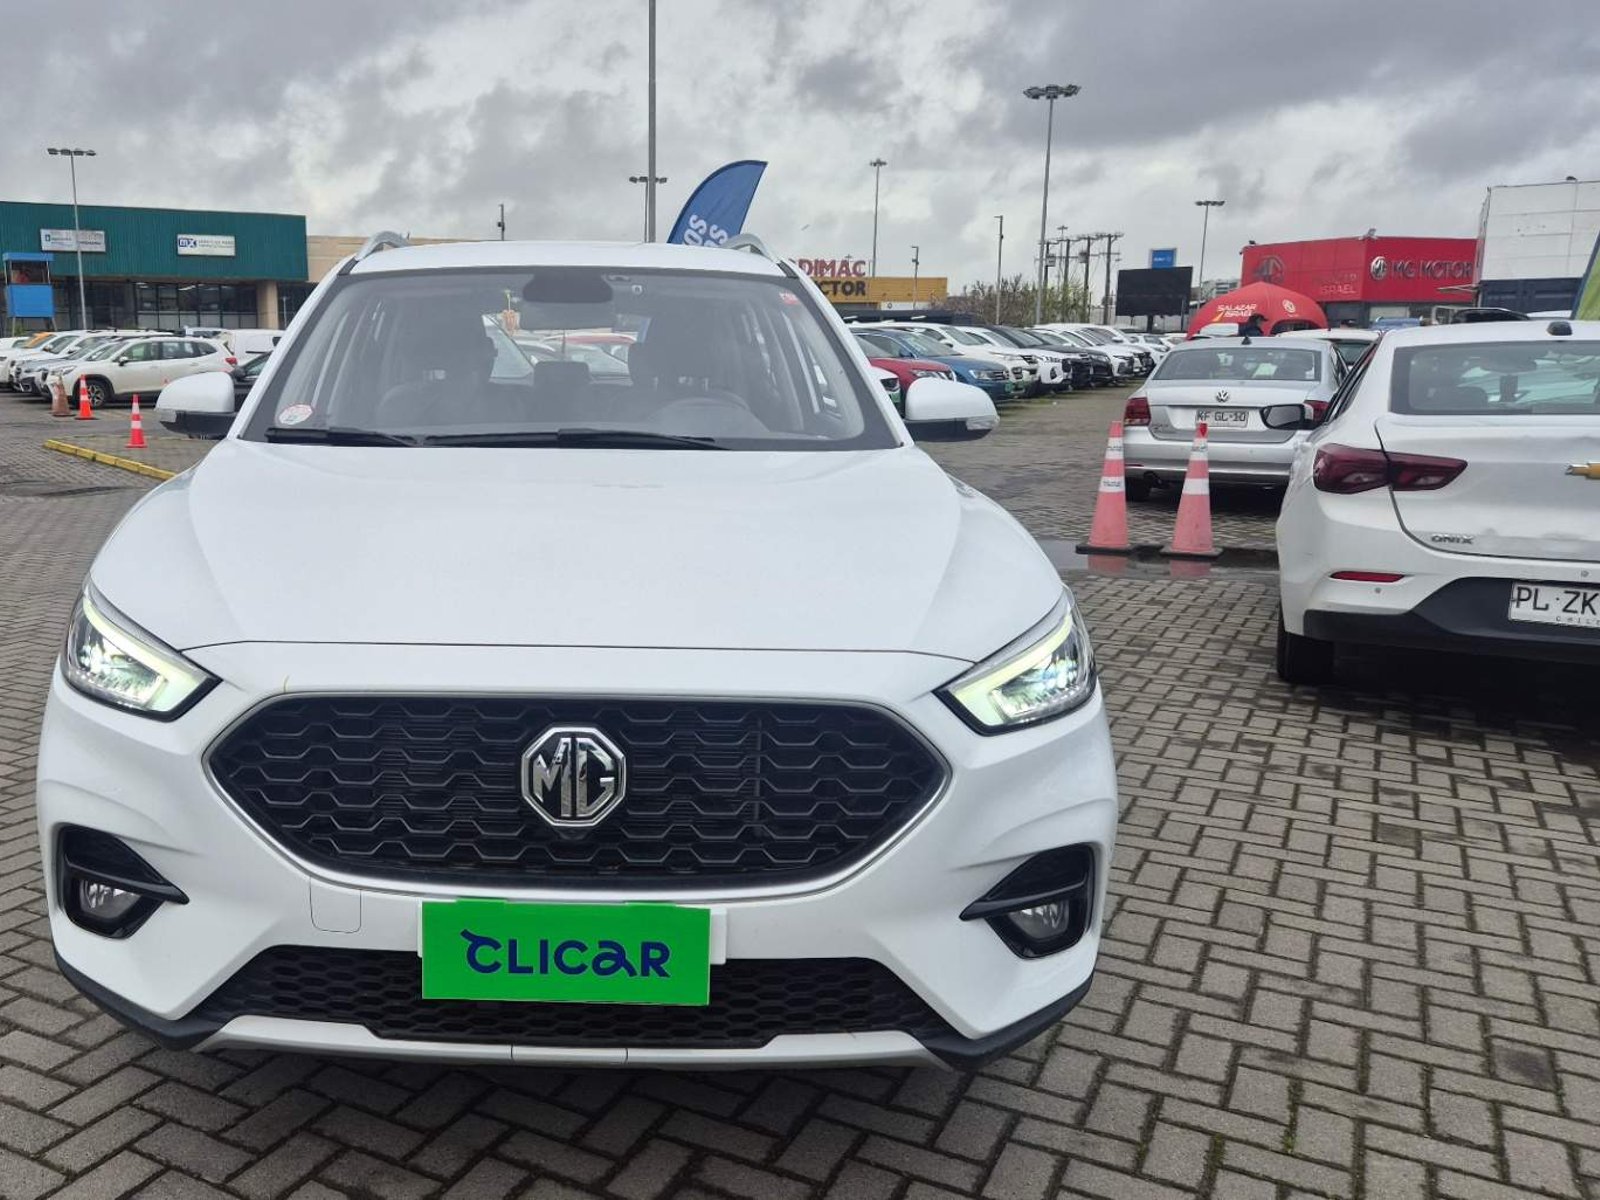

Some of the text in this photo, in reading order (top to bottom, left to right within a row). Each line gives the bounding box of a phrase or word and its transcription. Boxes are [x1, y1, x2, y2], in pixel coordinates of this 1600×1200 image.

[789, 259, 866, 278] DIMAC
[1393, 259, 1474, 280] MG MOTOR
[815, 280, 866, 297] CTOR
[1216, 303, 1257, 312] SALAZAR
[529, 734, 617, 820] MG
